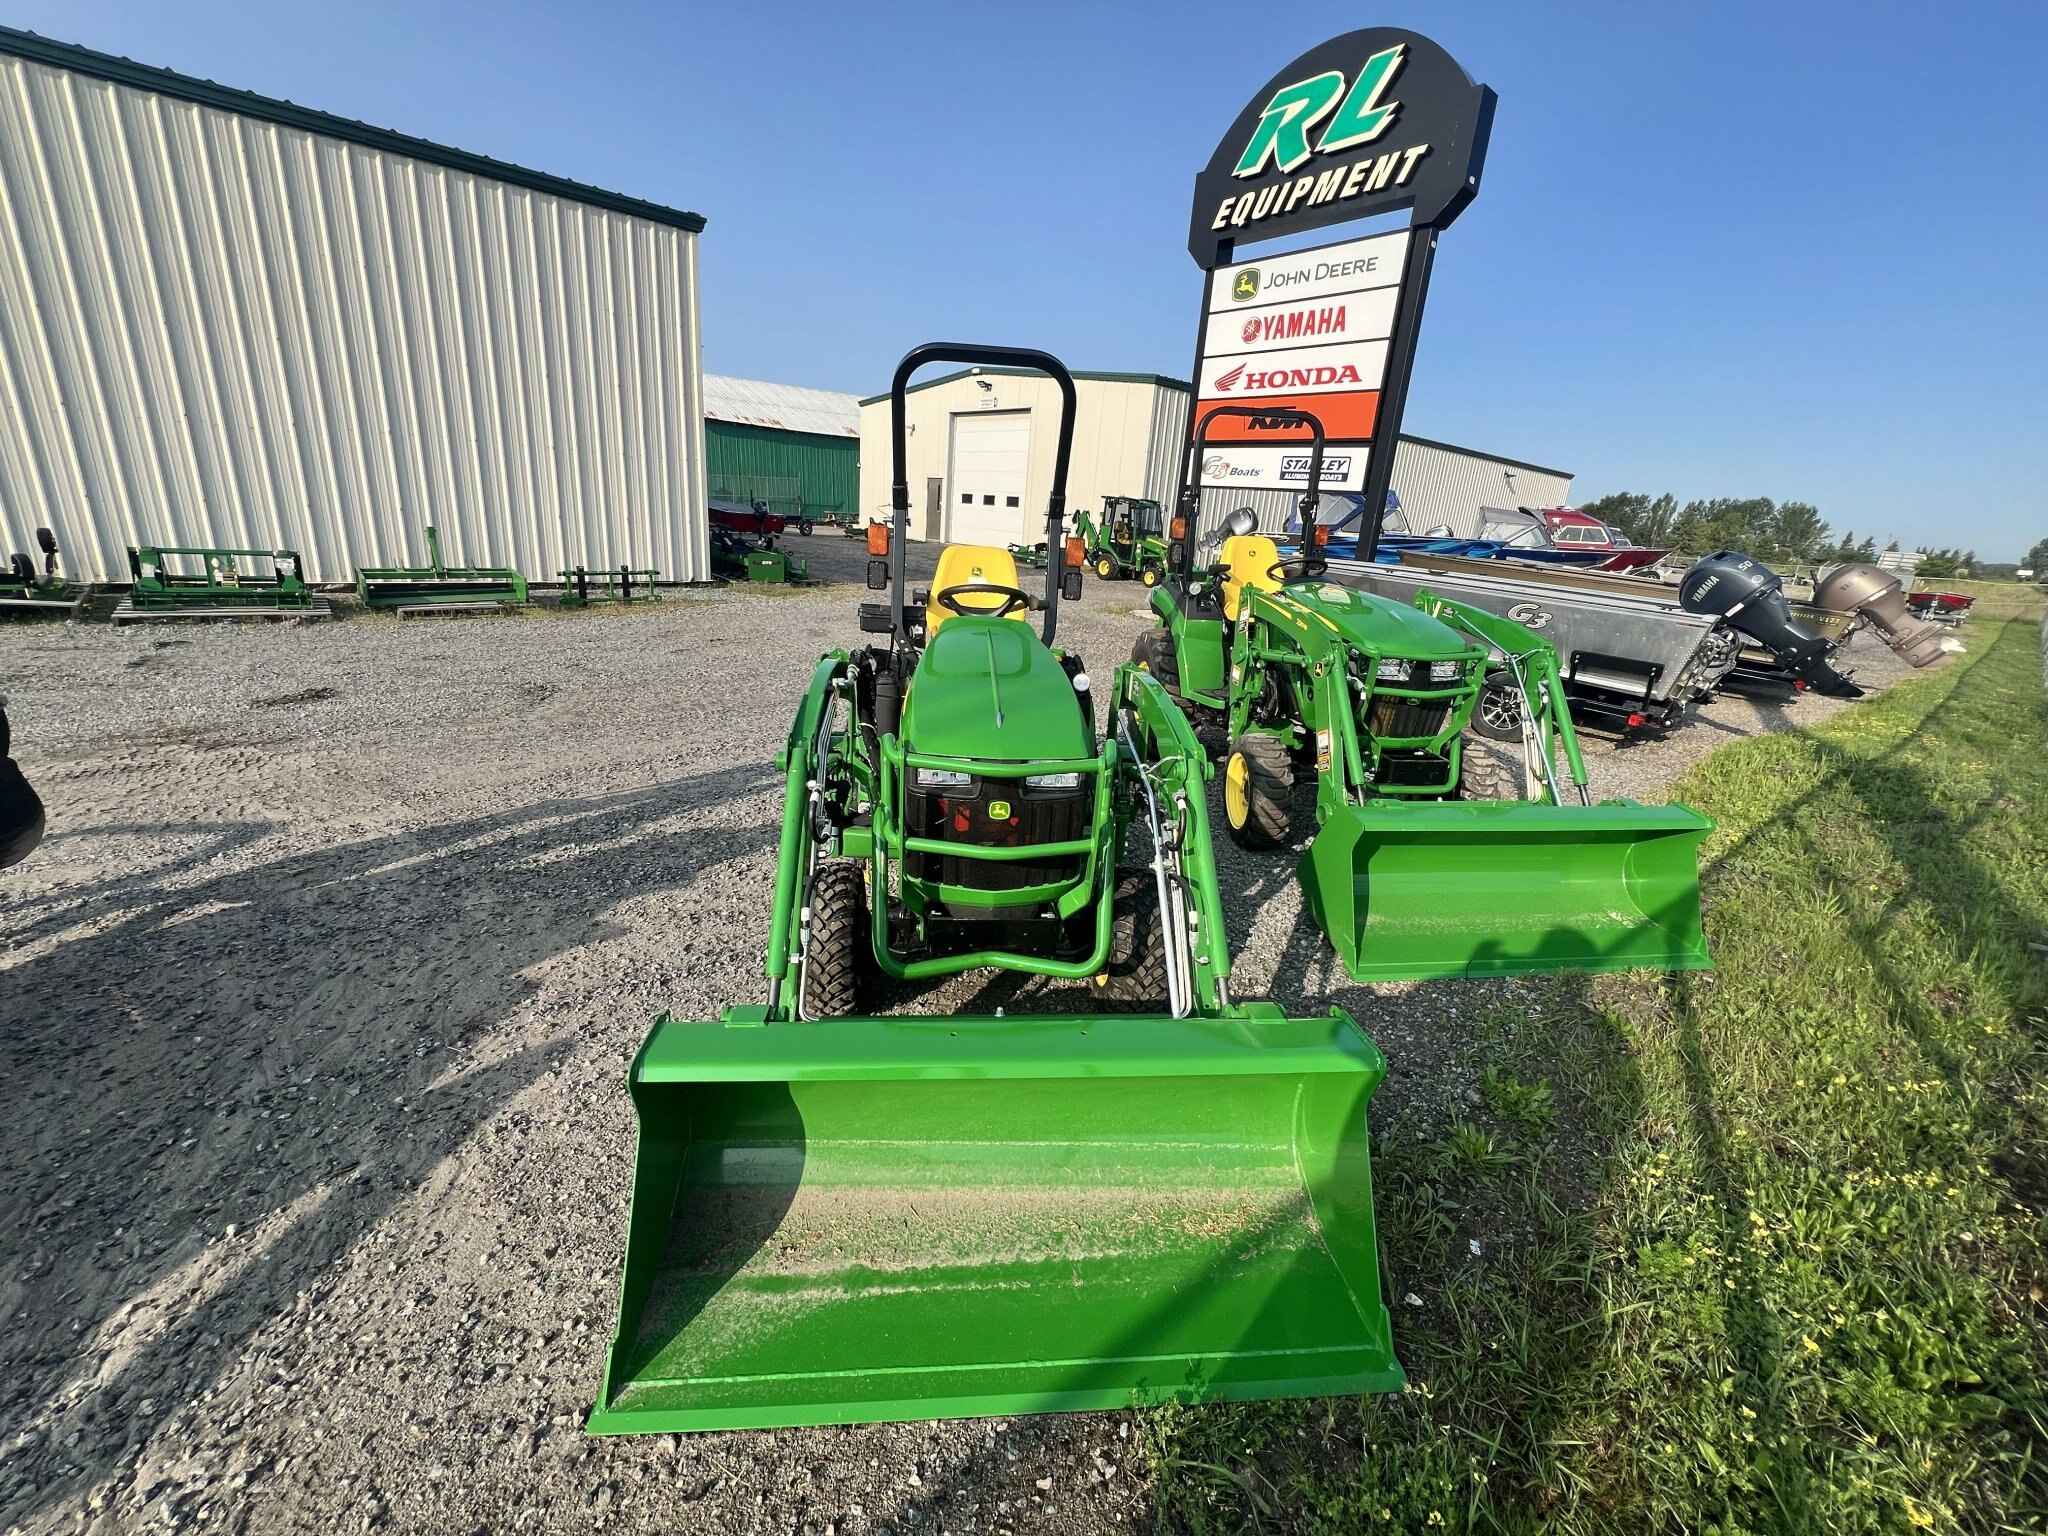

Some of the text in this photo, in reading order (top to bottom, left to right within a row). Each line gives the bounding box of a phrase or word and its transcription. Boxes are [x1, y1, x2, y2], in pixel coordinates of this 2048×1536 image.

[1231, 42, 1406, 179] RL
[1211, 143, 1430, 230] EQUIPMENT
[1263, 256, 1379, 290] JOHN DEERE
[1263, 305, 1347, 341] YAMAHA
[1243, 364, 1362, 390] HONDA
[1202, 455, 1260, 479] G3 Boats
[1284, 459, 1347, 471] STALEY
[1320, 473, 1343, 481] BOATS
[1737, 560, 1754, 571] 50
[1691, 575, 1720, 603] YAMAHA
[1507, 603, 1553, 629] G3
